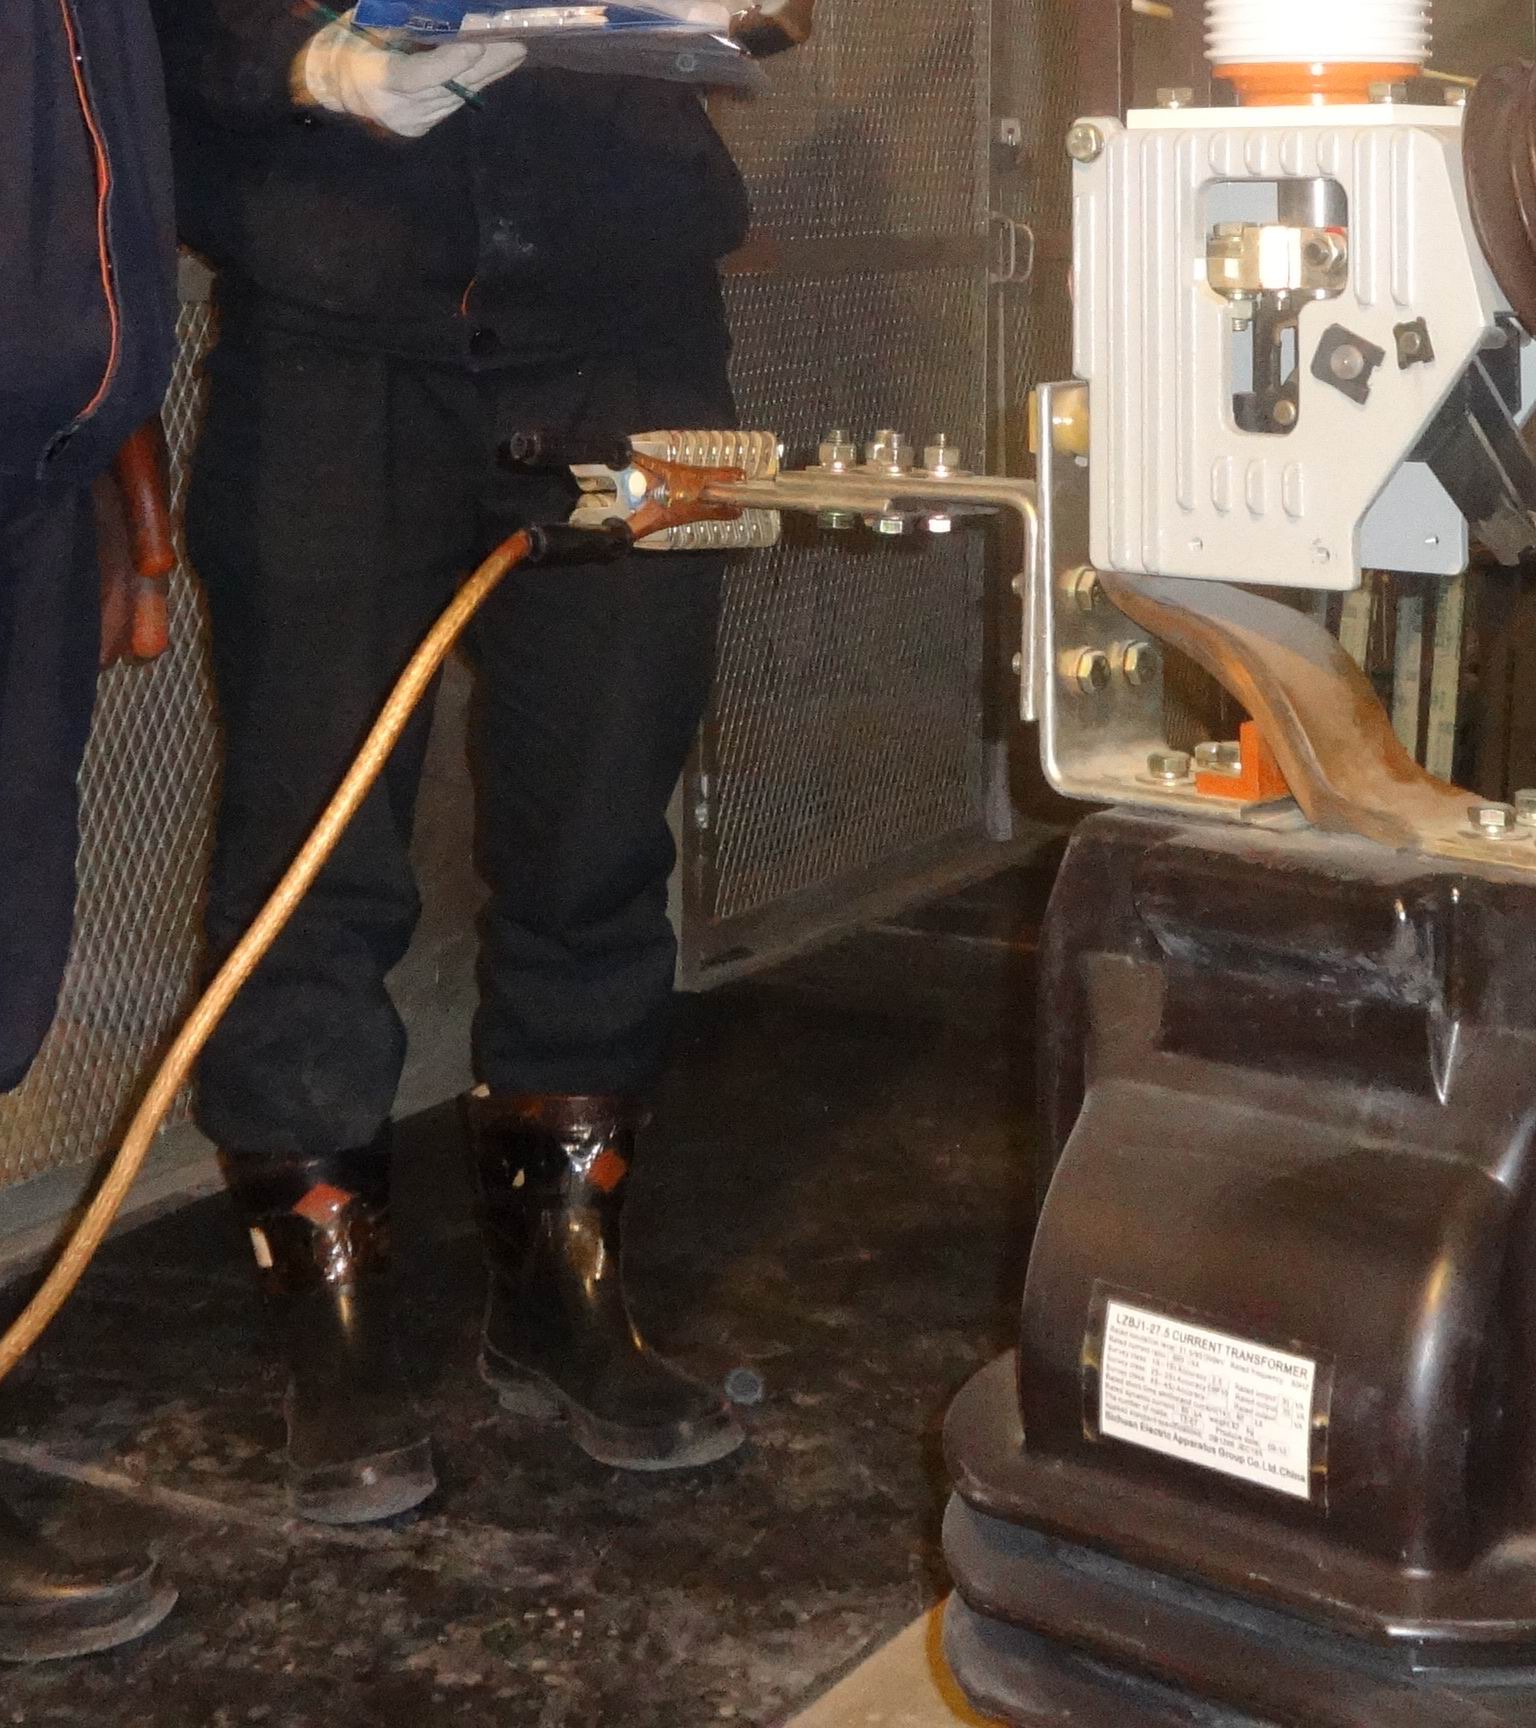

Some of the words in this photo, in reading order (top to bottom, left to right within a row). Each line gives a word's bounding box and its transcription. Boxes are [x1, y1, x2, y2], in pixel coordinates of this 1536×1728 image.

[1171, 1328, 1222, 1355] CURRENT
[1225, 1344, 1307, 1380] TRANSFORMER
[1173, 1432, 1216, 1455] Apparatus
[1218, 1446, 1245, 1465] Group
